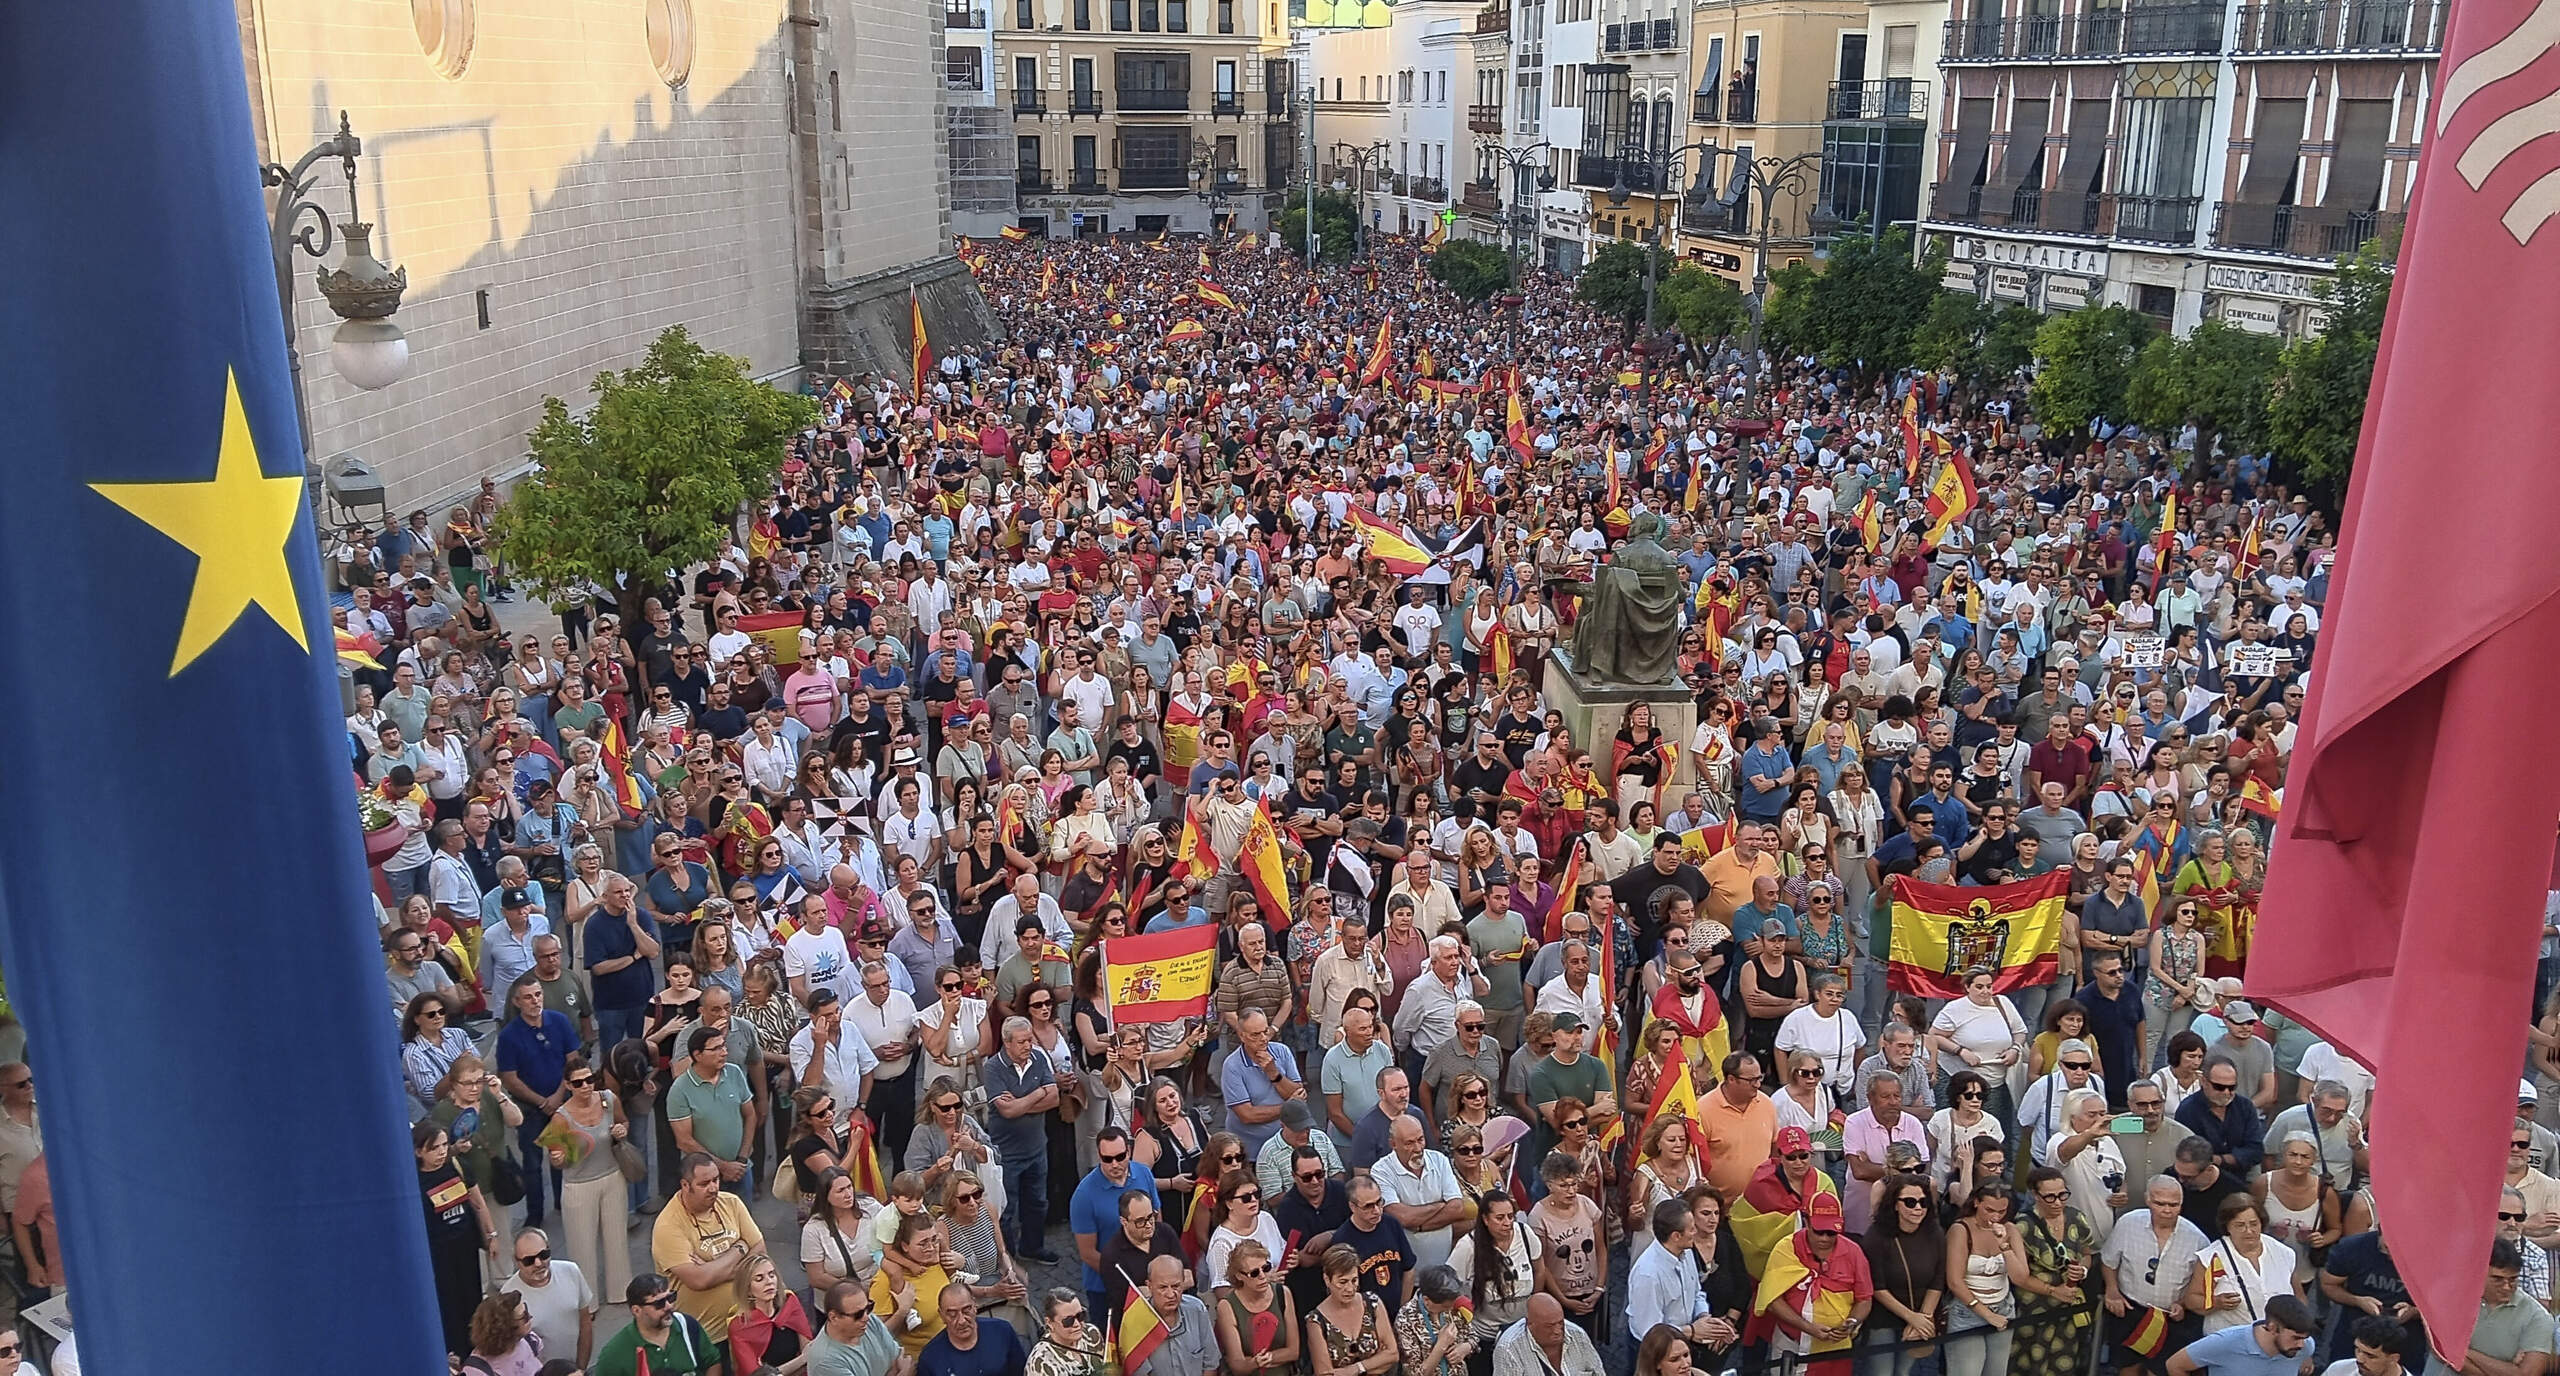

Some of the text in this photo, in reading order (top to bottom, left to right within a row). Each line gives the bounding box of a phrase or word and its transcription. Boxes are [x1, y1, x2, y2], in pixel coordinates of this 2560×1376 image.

[1995, 275, 2027, 285] PEPE JEREZ
[2209, 266, 2246, 289] COLEGIO
[2226, 309, 2276, 323] CERVECERÍA
[1360, 1249, 1401, 1274] ESPAÑA
